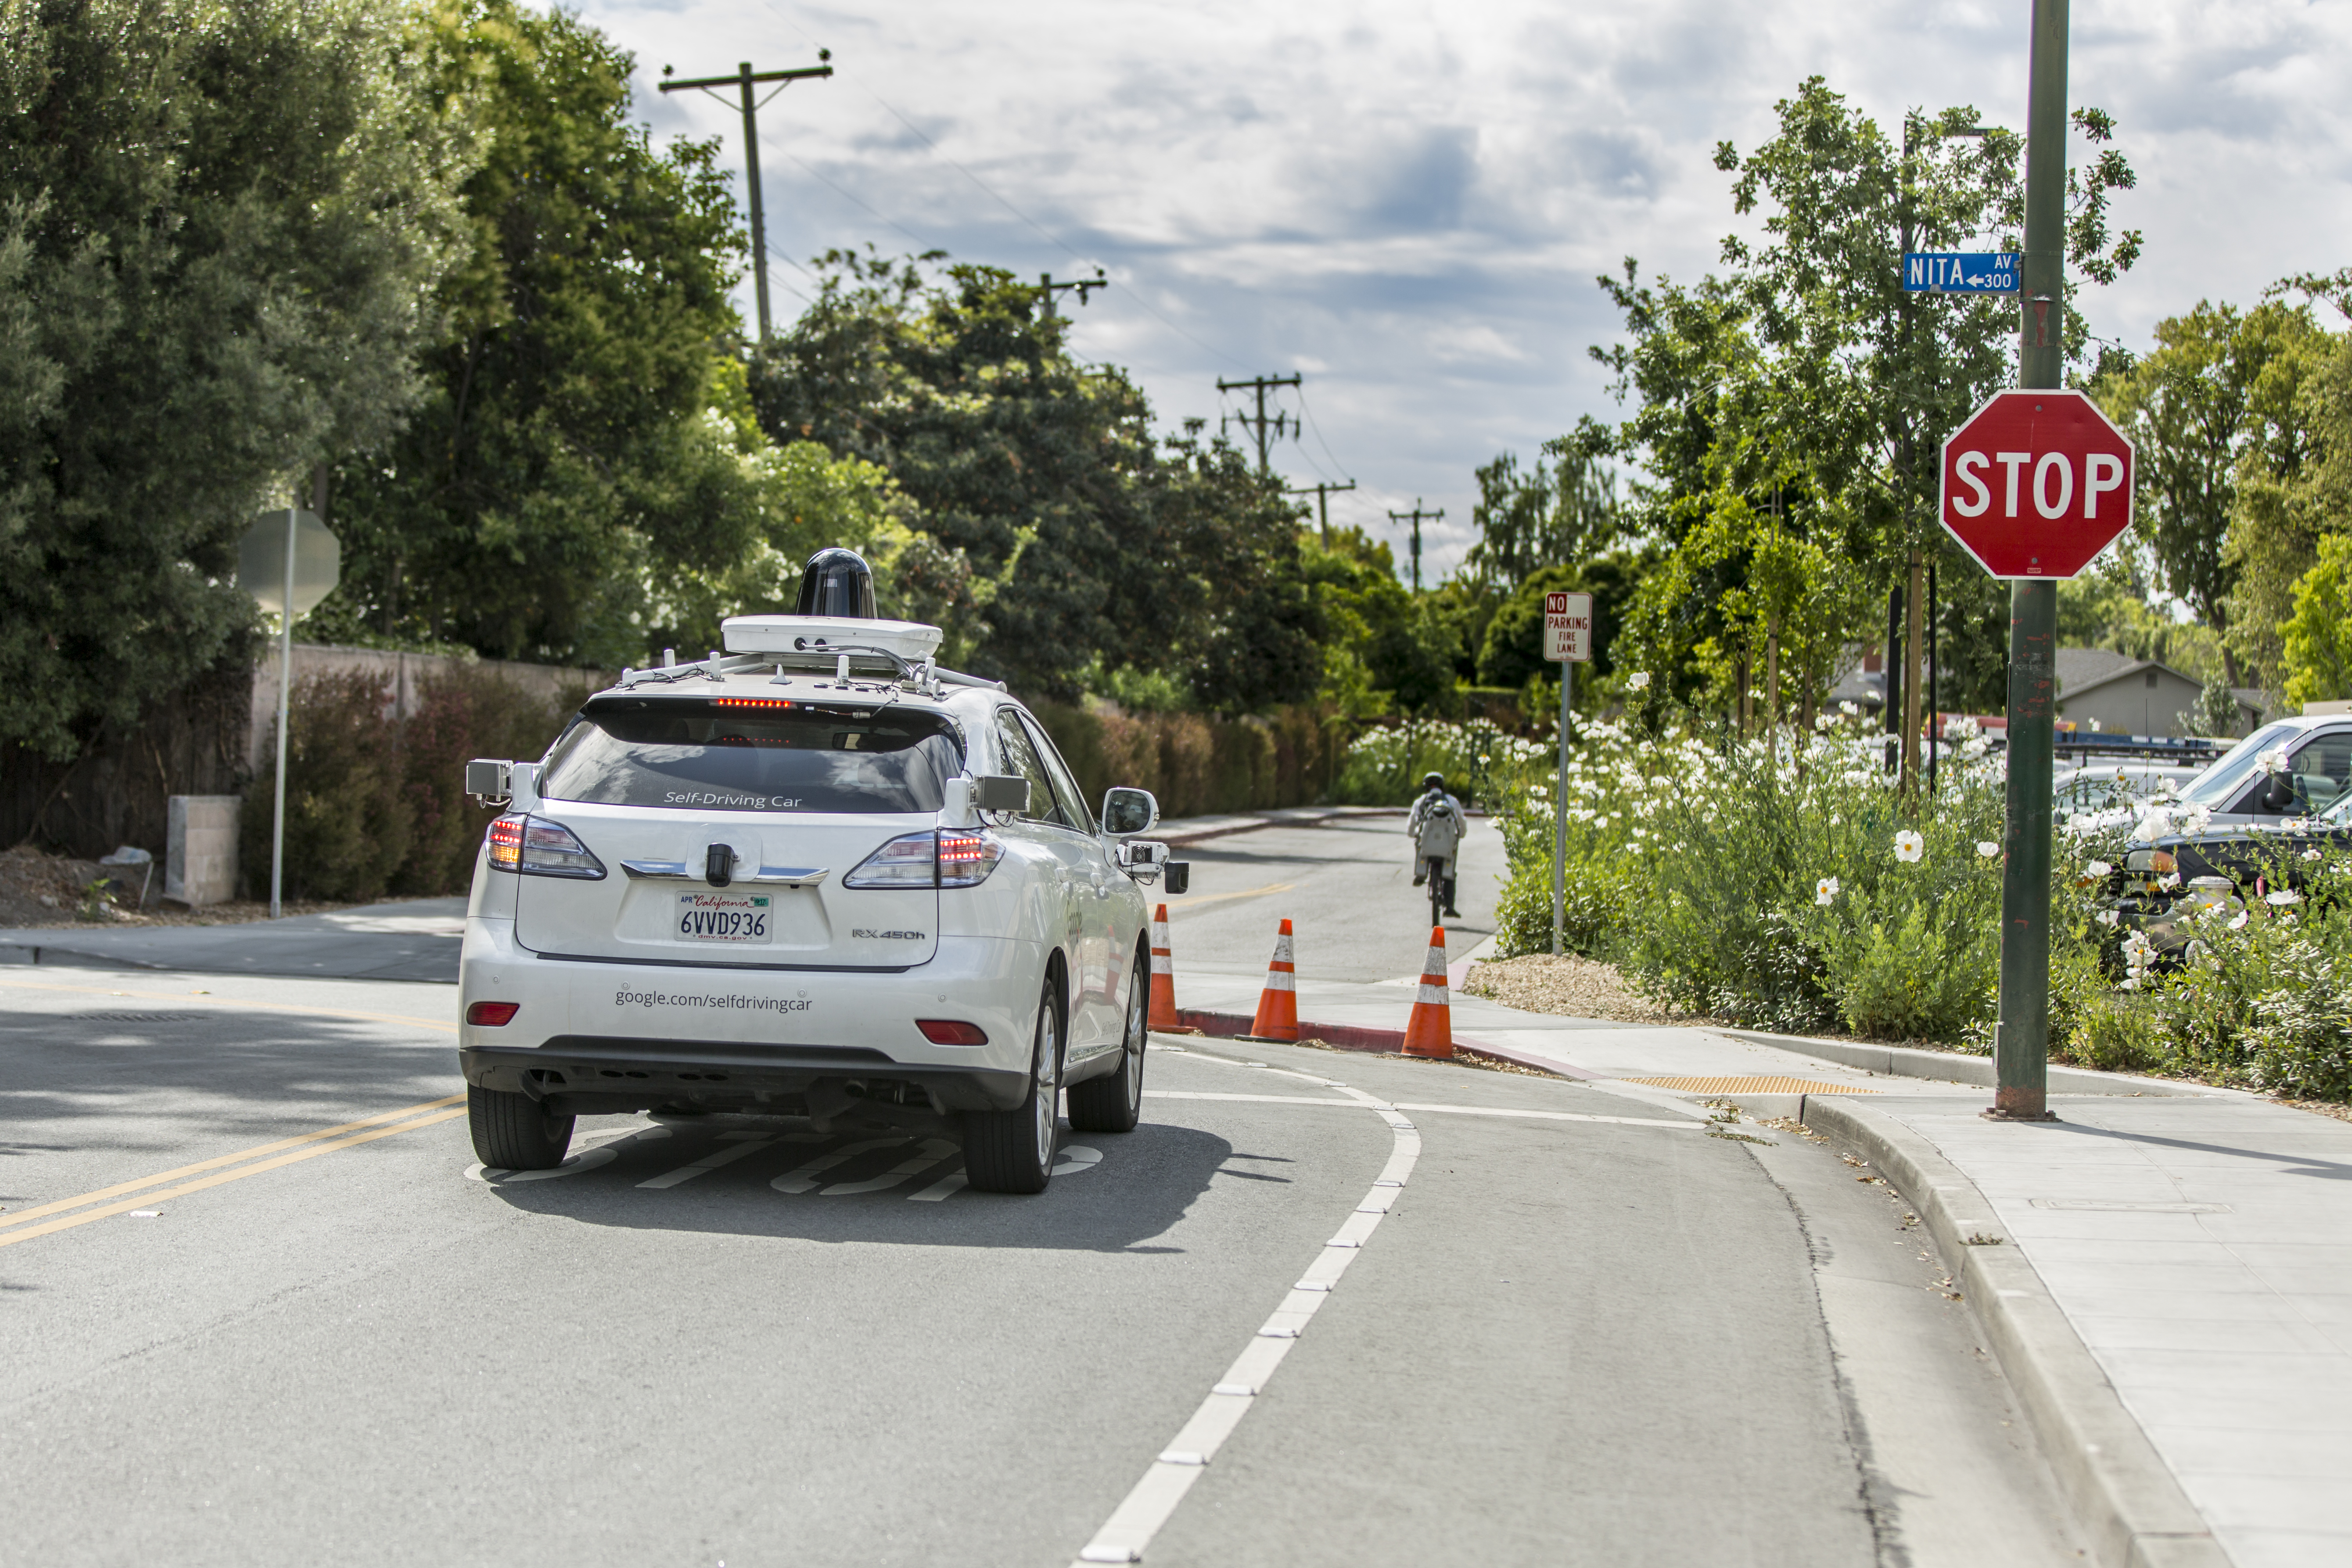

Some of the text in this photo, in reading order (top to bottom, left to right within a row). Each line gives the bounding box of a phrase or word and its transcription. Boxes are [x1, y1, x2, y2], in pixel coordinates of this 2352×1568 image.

[1994, 255, 2011, 269] AV
[1911, 258, 2011, 288] NITA 300
[1953, 451, 2124, 519] STOP
[1549, 596, 1565, 612] NO
[1548, 616, 1587, 630] PARKING
[1559, 632, 1575, 642] FIRE
[1557, 644, 1576, 653] LANE
[664, 792, 802, 809] Self-Driving Car
[696, 895, 754, 910] California
[681, 911, 765, 936] 6VVD936
[1067, 900, 1082, 944] Google
[852, 929, 925, 940] RX 450h
[616, 990, 812, 1014] google.com/selfdrivingcar
